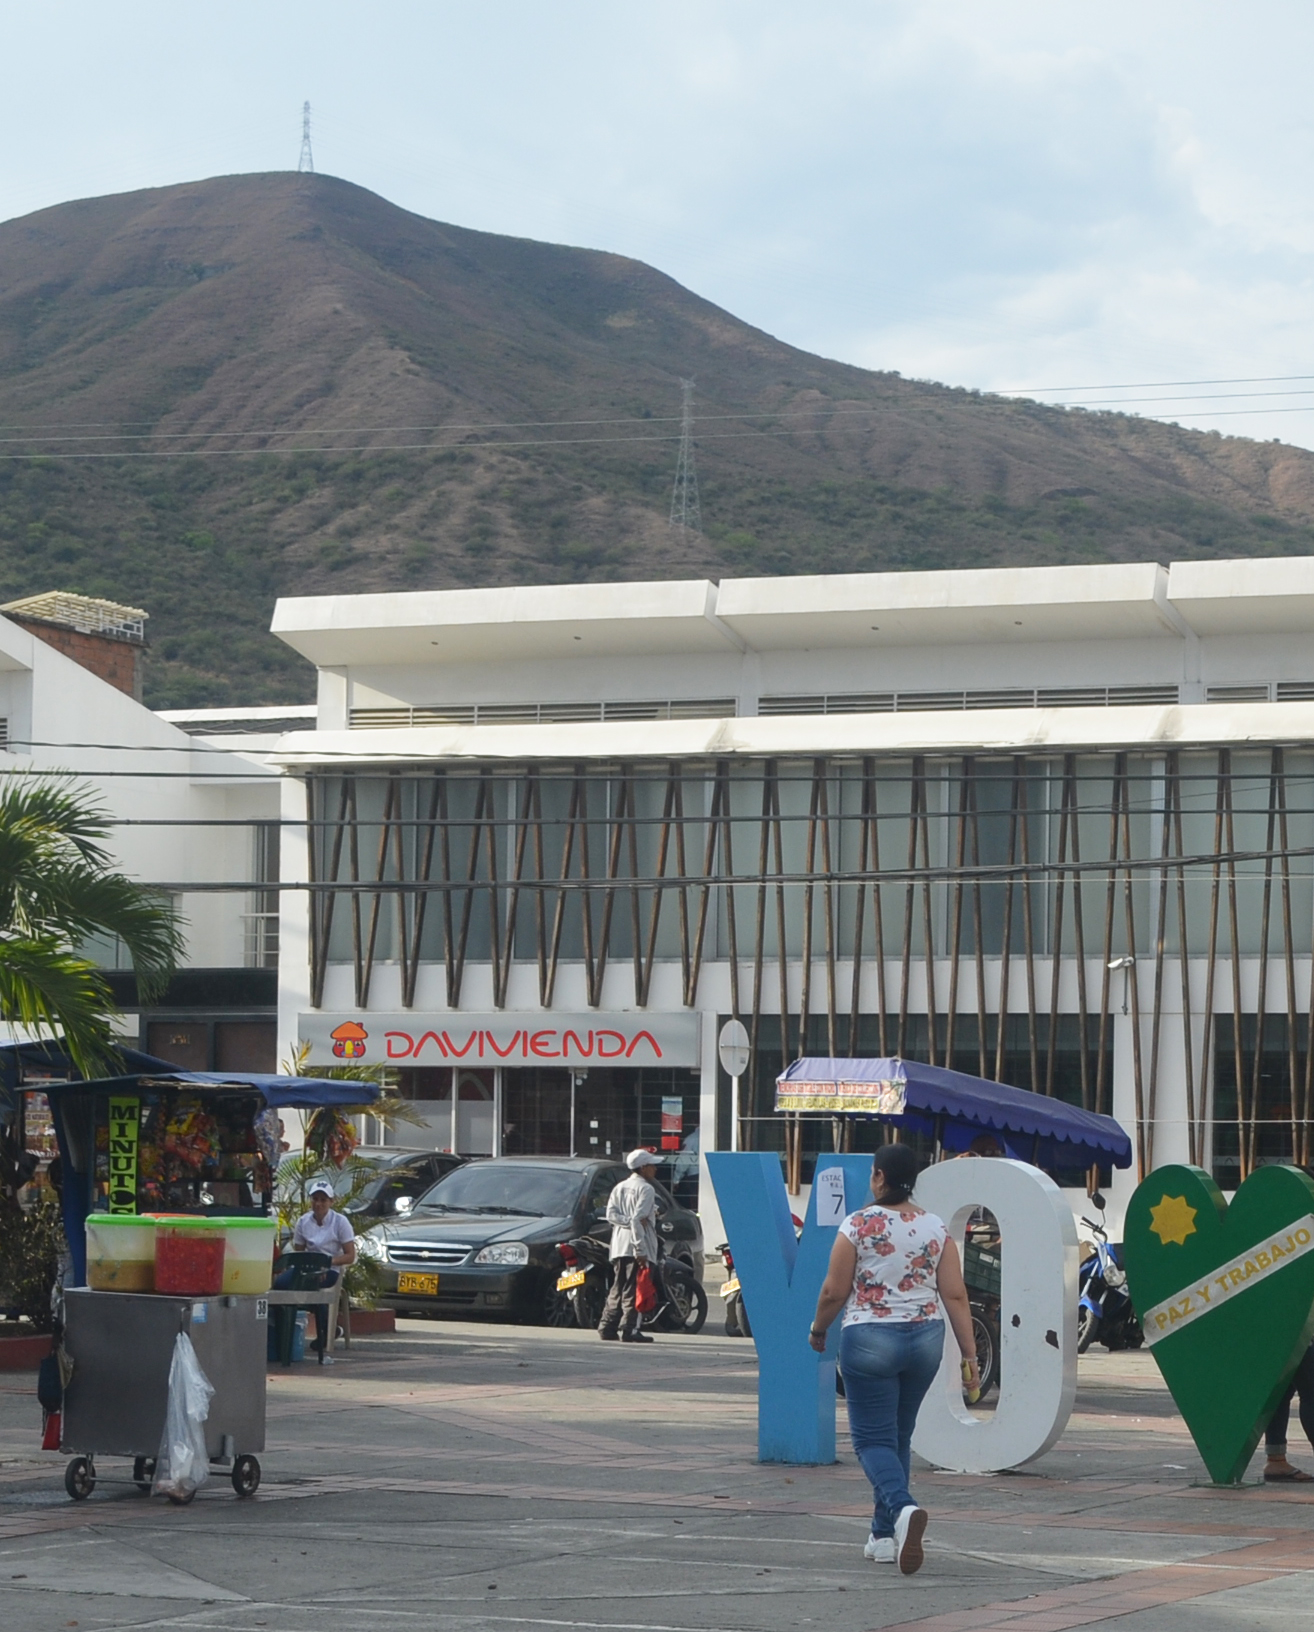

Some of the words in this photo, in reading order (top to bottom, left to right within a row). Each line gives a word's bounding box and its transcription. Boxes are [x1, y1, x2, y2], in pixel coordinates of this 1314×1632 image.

[384, 1030, 663, 1058] DAVIVIENDA
[832, 1193, 844, 1215] 7
[1154, 1297, 1196, 1330] PAZ
[1196, 1285, 1211, 1304] Y
[1214, 1228, 1311, 1292] TRABAJO
